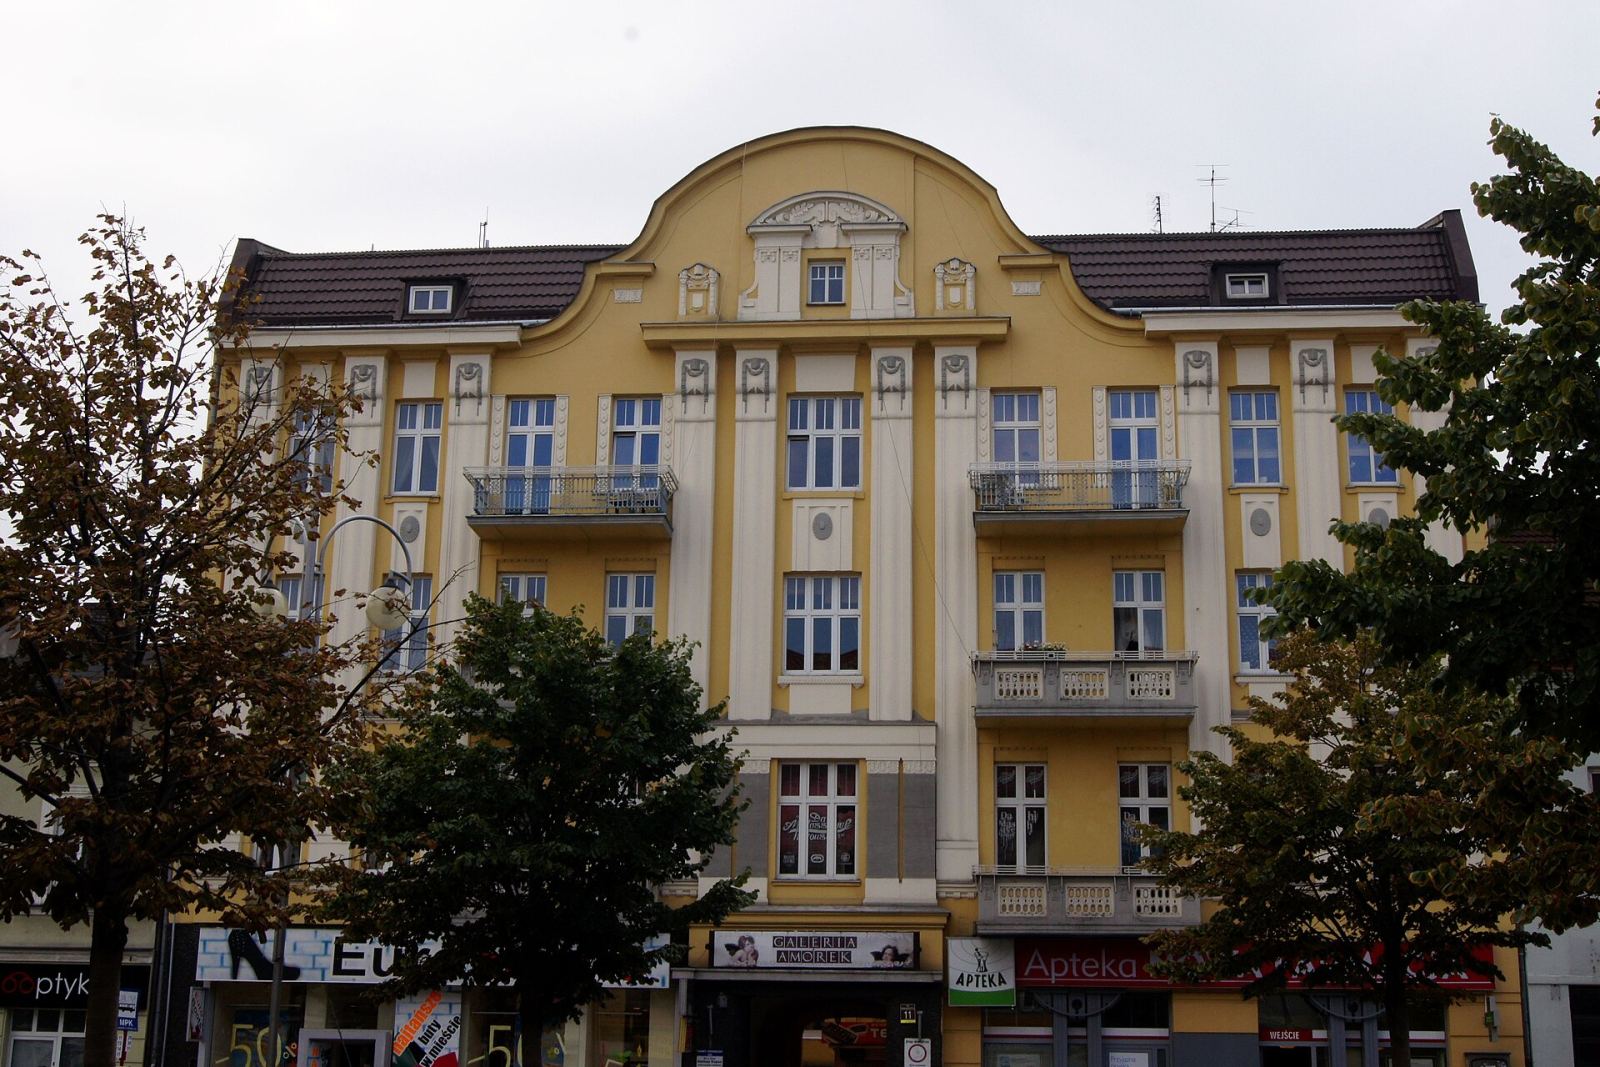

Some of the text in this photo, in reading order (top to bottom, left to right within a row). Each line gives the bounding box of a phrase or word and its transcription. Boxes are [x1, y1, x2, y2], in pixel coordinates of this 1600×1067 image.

[773, 936, 857, 948] GALERIA
[777, 951, 851, 963] AMOREK
[1024, 947, 1137, 984] Apteka
[956, 972, 1007, 988] APTEKA
[418, 1019, 442, 1046] buty
[428, 1015, 461, 1060] mieście
[1269, 1029, 1300, 1040] WEJŚCIE
